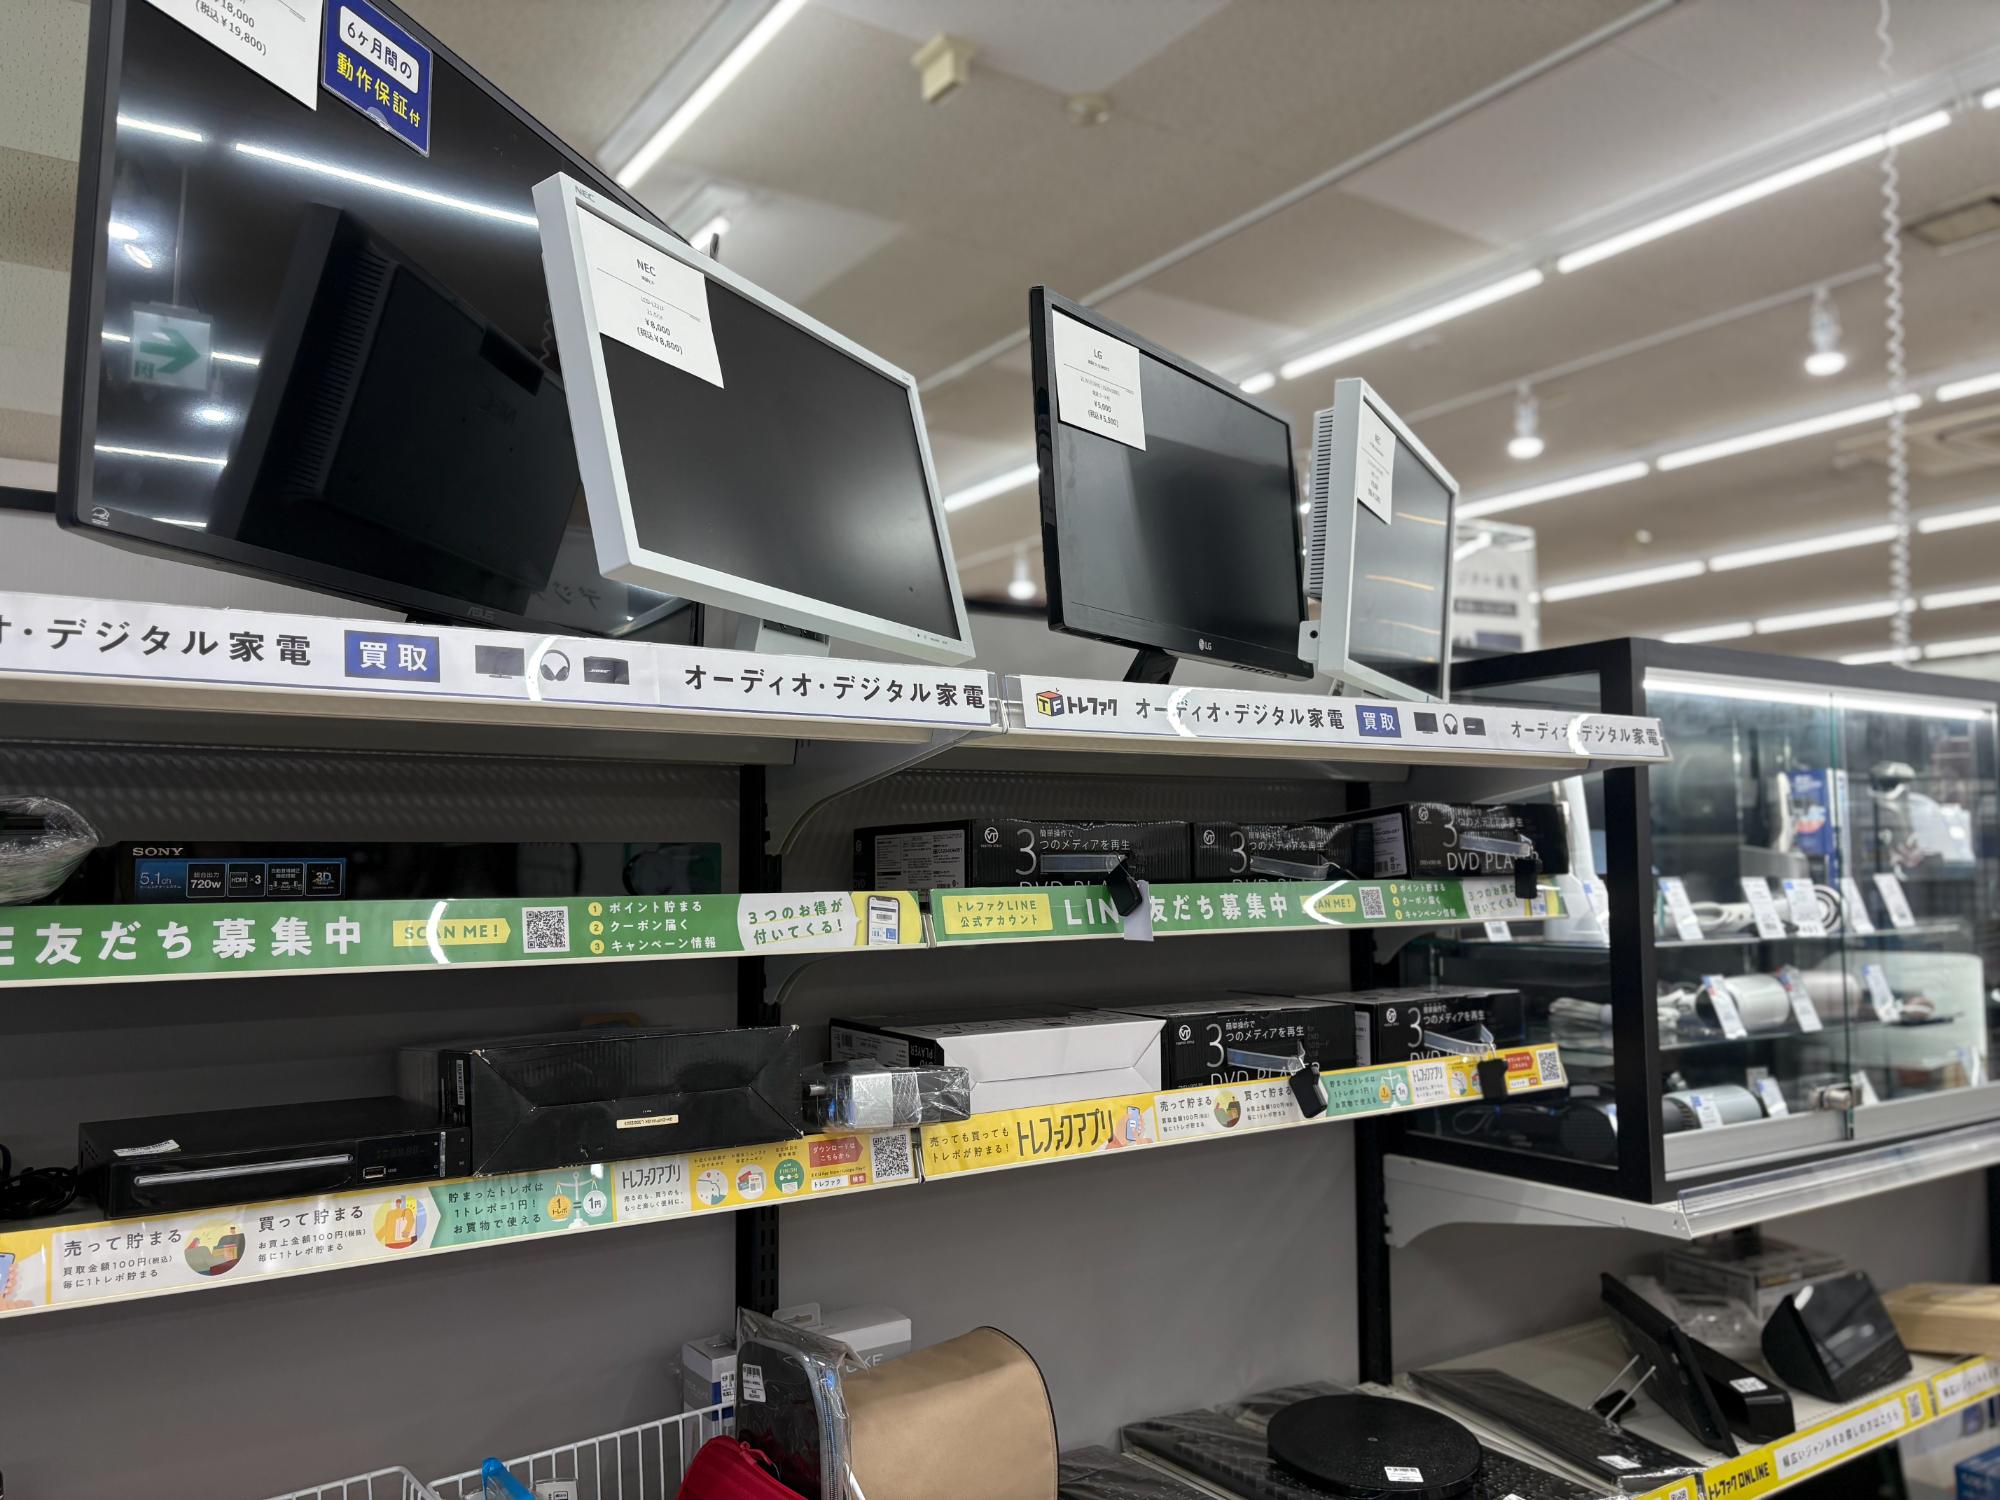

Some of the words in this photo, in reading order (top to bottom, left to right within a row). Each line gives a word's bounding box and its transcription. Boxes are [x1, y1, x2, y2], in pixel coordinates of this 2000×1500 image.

[336, 51, 421, 128] 動作保証付
[575, 186, 595, 203] NEC
[636, 258, 656, 277] NEC
[645, 318, 670, 336] ¥8,000
[1093, 348, 1103, 360] LG
[467, 606, 496, 621] ASUS
[358, 641, 428, 672] 買取
[684, 664, 986, 710] オーディオ・デジタル家電
[1066, 695, 1118, 717] トレファク
[1362, 711, 1396, 731] 買取
[132, 847, 184, 857] SONY
[1040, 839, 1131, 851] つのメディアを再生
[1447, 852, 1480, 871] DVD
[139, 871, 172, 886] 5.1ch
[231, 876, 249, 884] HDMI
[315, 871, 332, 882] 3D
[609, 900, 702, 914] ポイント貯まる
[747, 898, 843, 925] 3つのお得が
[956, 899, 1037, 913] トレファクLINE
[610, 918, 688, 933] クーポン届く
[960, 914, 1038, 929] 公式アカウント
[611, 936, 717, 952] キャンペーン情報
[1225, 1026, 1305, 1042] つのメディアを再生
[1244, 1085, 1292, 1101] 買って貯まる
[1159, 1096, 1212, 1112] 売って貯まる
[929, 1128, 1010, 1148] 売っても買っても
[1016, 1108, 1114, 1157] トレファクアプリ
[622, 1163, 681, 1190] トレファクアプリ
[814, 1178, 841, 1188] トレファク
[448, 1182, 544, 1204] 貯まったトレポは
[588, 1197, 602, 1210] 1円
[258, 1205, 364, 1233] 買って貯まる
[453, 1213, 541, 1235] お買物で使える
[63, 1228, 182, 1258] 売って貯まる
[63, 1255, 173, 1276] 買取金額100円(税込)
[1738, 1461, 1770, 1490] ONLINE
